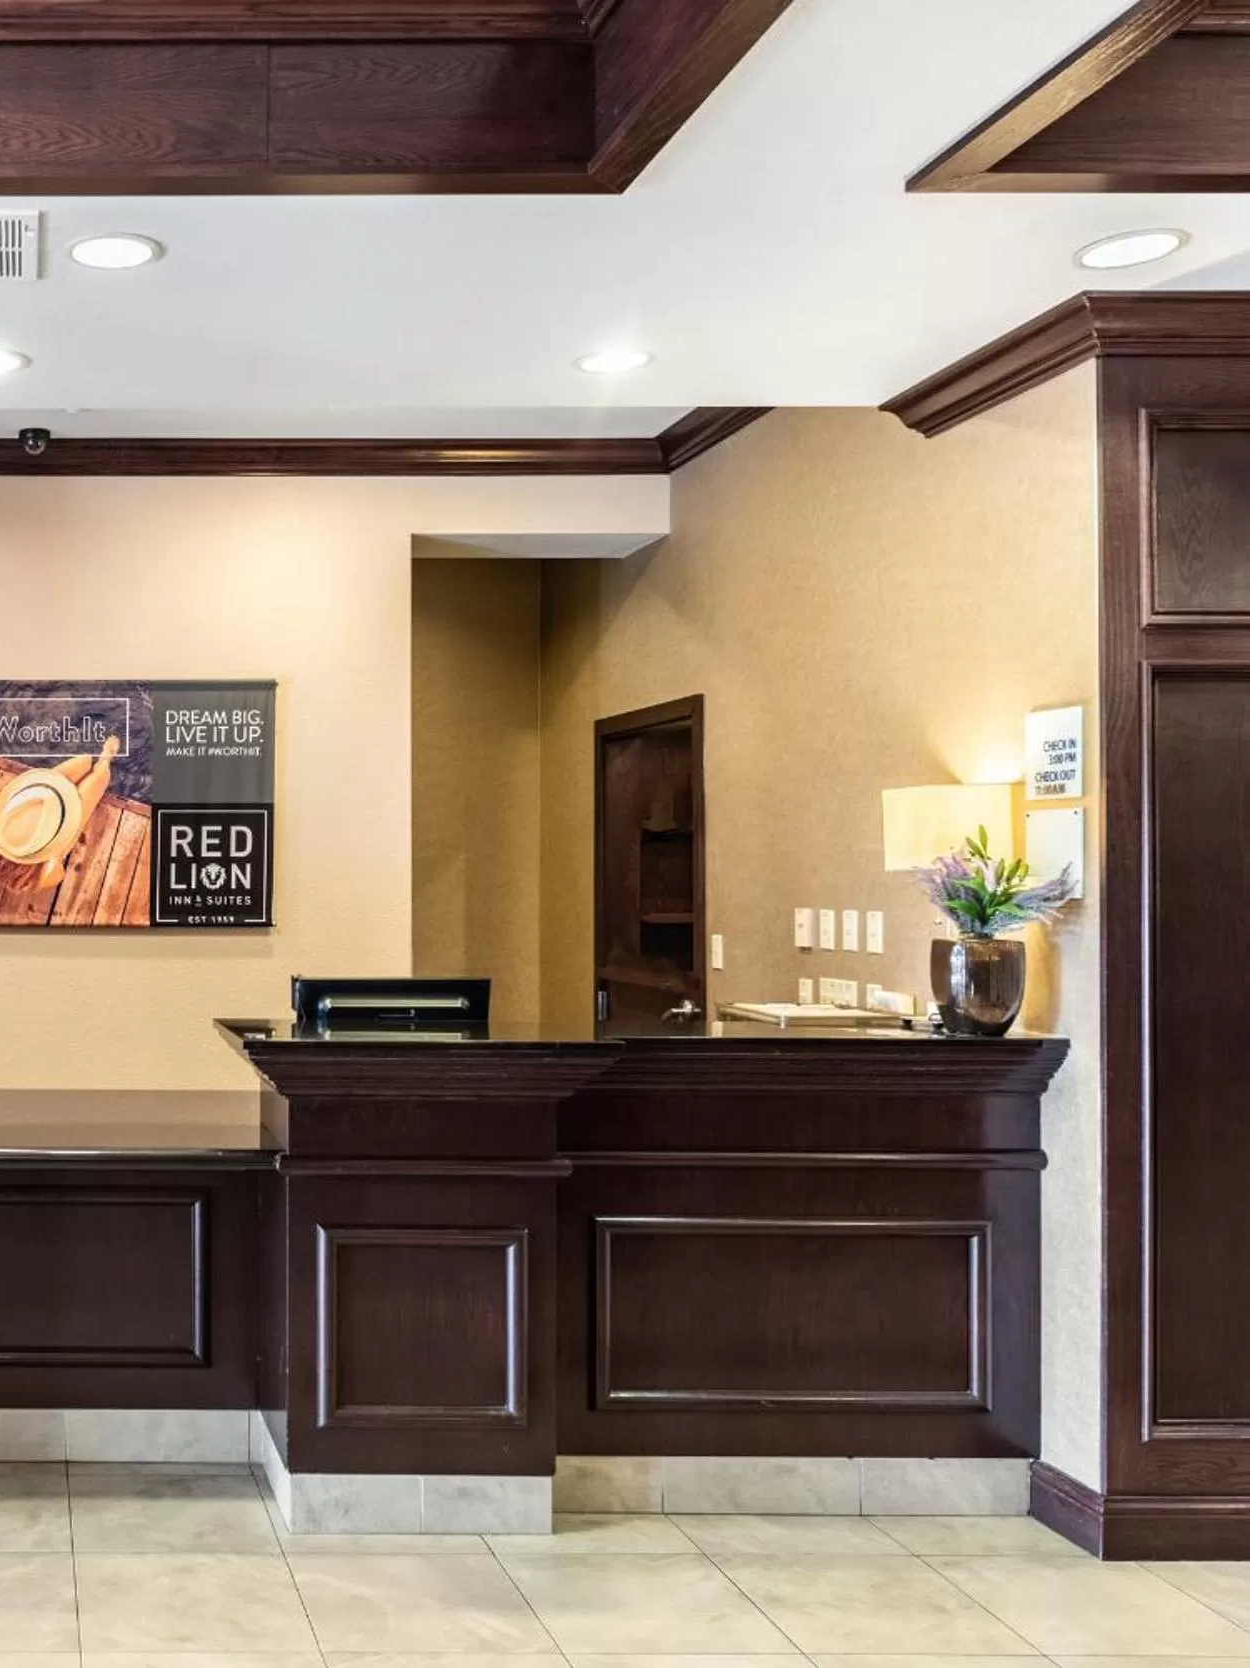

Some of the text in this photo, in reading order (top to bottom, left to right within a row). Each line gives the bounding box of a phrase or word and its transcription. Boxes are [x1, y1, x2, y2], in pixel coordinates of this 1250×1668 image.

[165, 709, 264, 725] DREAM BIG.
[165, 726, 264, 743] LIVE IT UP.
[166, 747, 196, 756] MAKE
[198, 747, 206, 756] IT
[1043, 738, 1077, 752] CHECK IN
[1034, 769, 1076, 783] CHECK OUT
[171, 826, 253, 857] RED
[169, 896, 191, 905] INN
[206, 896, 252, 905] SUITES
